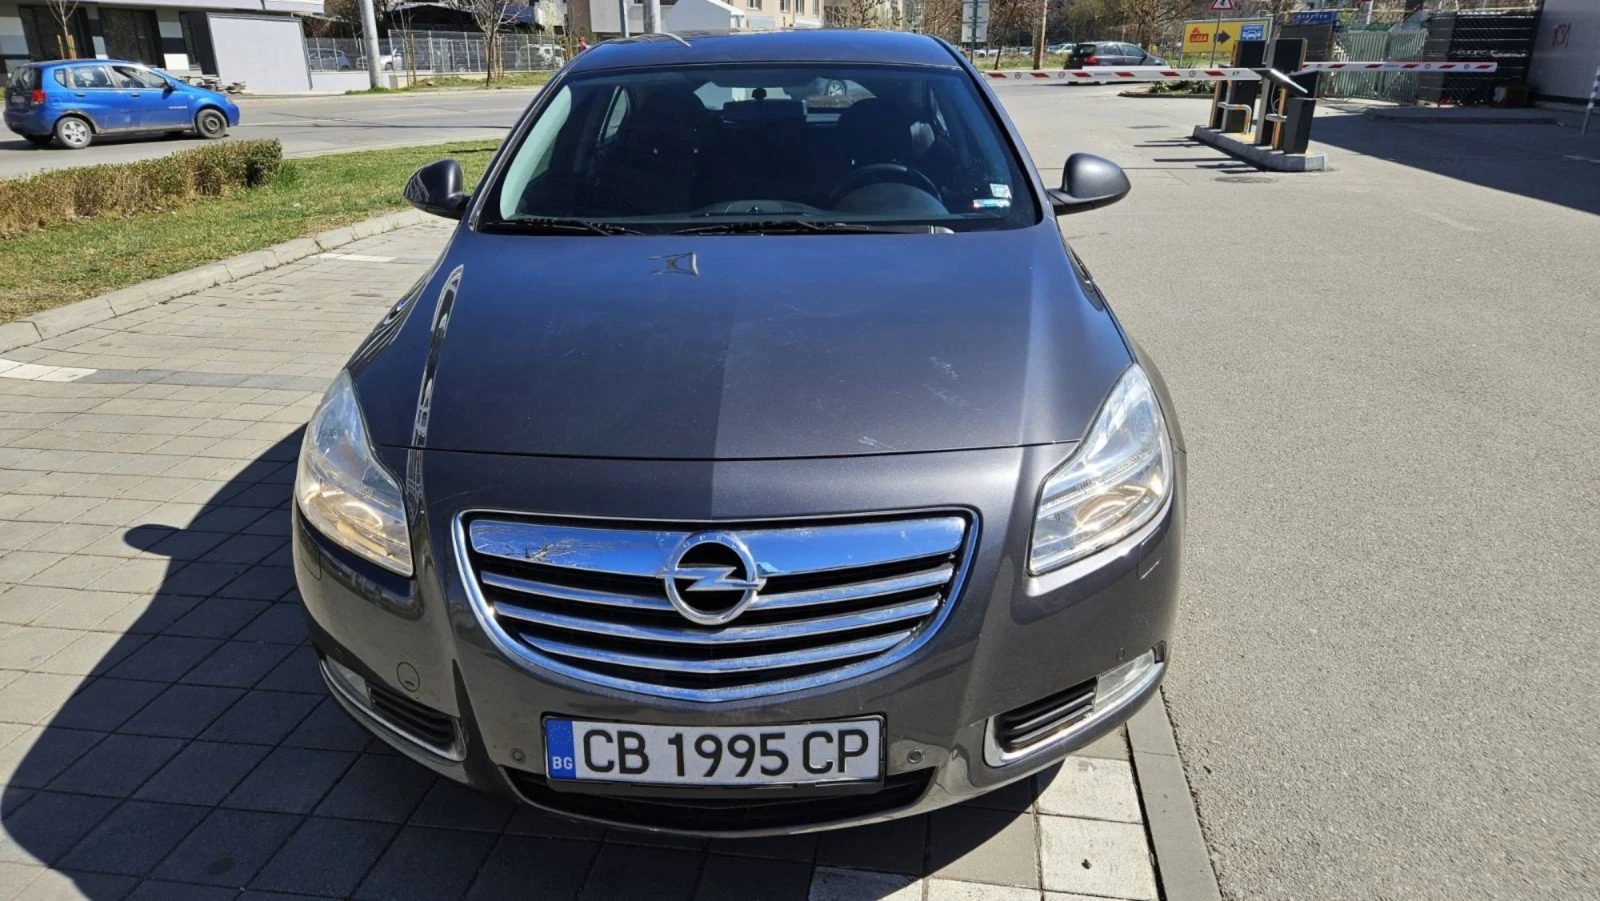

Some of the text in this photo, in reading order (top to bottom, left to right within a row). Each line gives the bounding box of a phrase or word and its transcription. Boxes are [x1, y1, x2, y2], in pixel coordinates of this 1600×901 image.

[682, 534, 738, 549] OPEL
[583, 728, 869, 777] CB 1995 CP
[552, 756, 573, 770] BG
